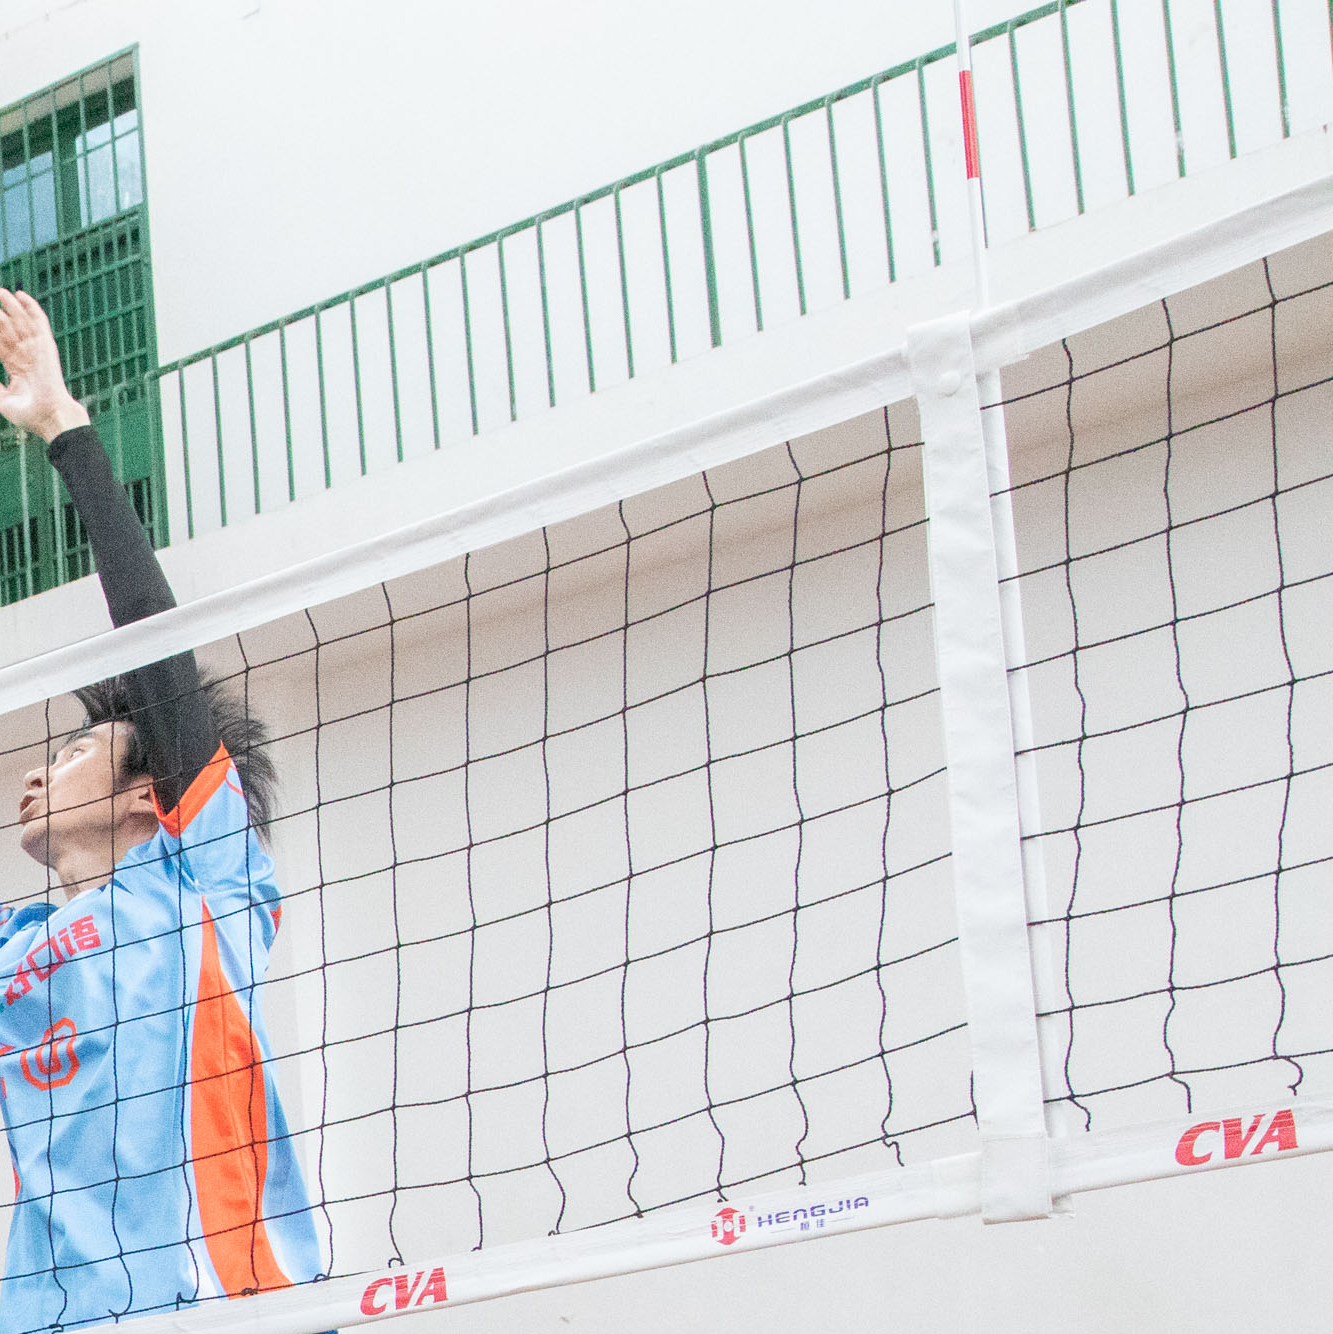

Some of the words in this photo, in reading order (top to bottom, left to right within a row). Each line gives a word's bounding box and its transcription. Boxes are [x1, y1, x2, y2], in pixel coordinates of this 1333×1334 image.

[1174, 1109, 1299, 1166] CVA
[757, 1196, 870, 1228] HENGJIA
[360, 1267, 449, 1316] CVA
